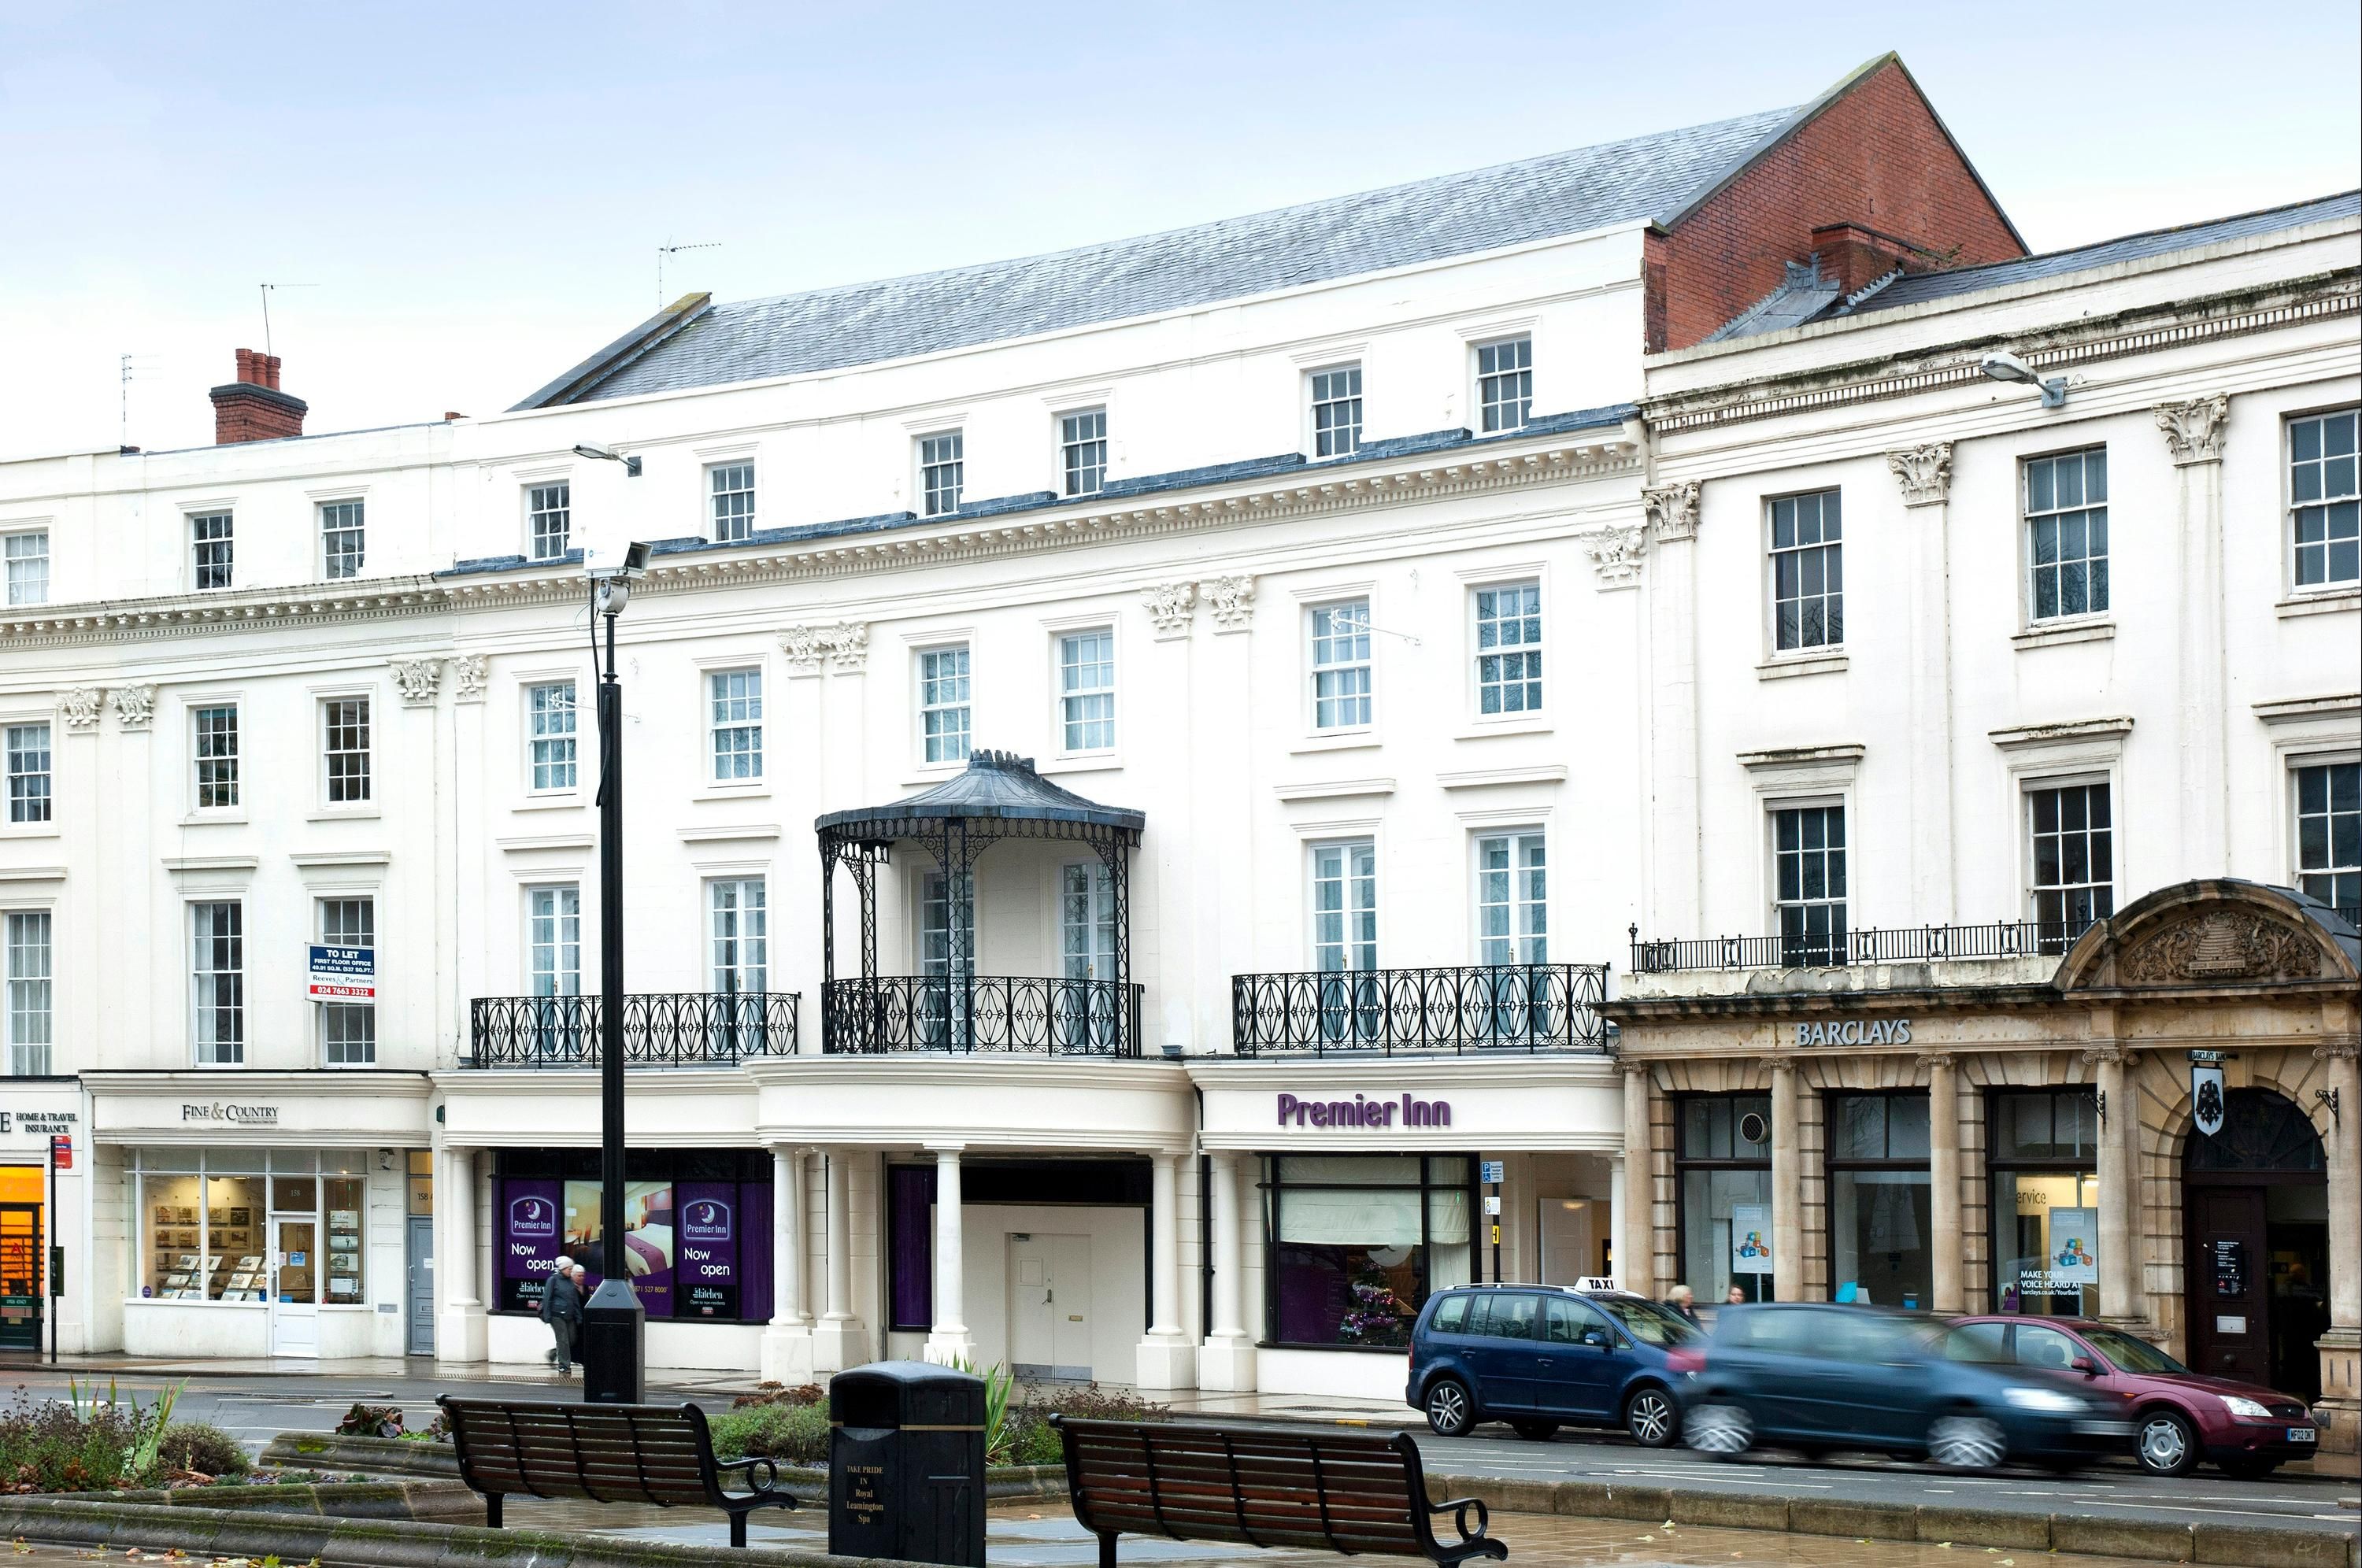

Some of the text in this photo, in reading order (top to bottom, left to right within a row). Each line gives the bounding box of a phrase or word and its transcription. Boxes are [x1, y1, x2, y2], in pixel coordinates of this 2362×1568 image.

[327, 949, 360, 960] TO LET
[1796, 1019, 1911, 1046] BARCLAYS
[183, 1101, 279, 1121] FINE & COUNTRY
[1277, 1093, 1451, 1126] Premier Inn
[16, 1112, 78, 1122] HOME & TRAVEL
[25, 1124, 68, 1133] INSURANCE
[2016, 1189, 2046, 1204] ervice
[514, 1220, 551, 1230] Premier Inn
[687, 1224, 727, 1233] Premier Inn
[512, 1243, 536, 1256] Now
[684, 1247, 710, 1260] Now
[527, 1259, 554, 1272] open
[700, 1264, 730, 1278] open
[2043, 1270, 2064, 1279] YOUR
[524, 1281, 545, 1292] kitche
[1588, 1279, 1614, 1290] TAXI
[846, 1465, 884, 1474] TAKE PRIDE
[855, 1488, 873, 1499] Royal
[846, 1501, 884, 1512] Leamington
[858, 1514, 871, 1525] Spa
